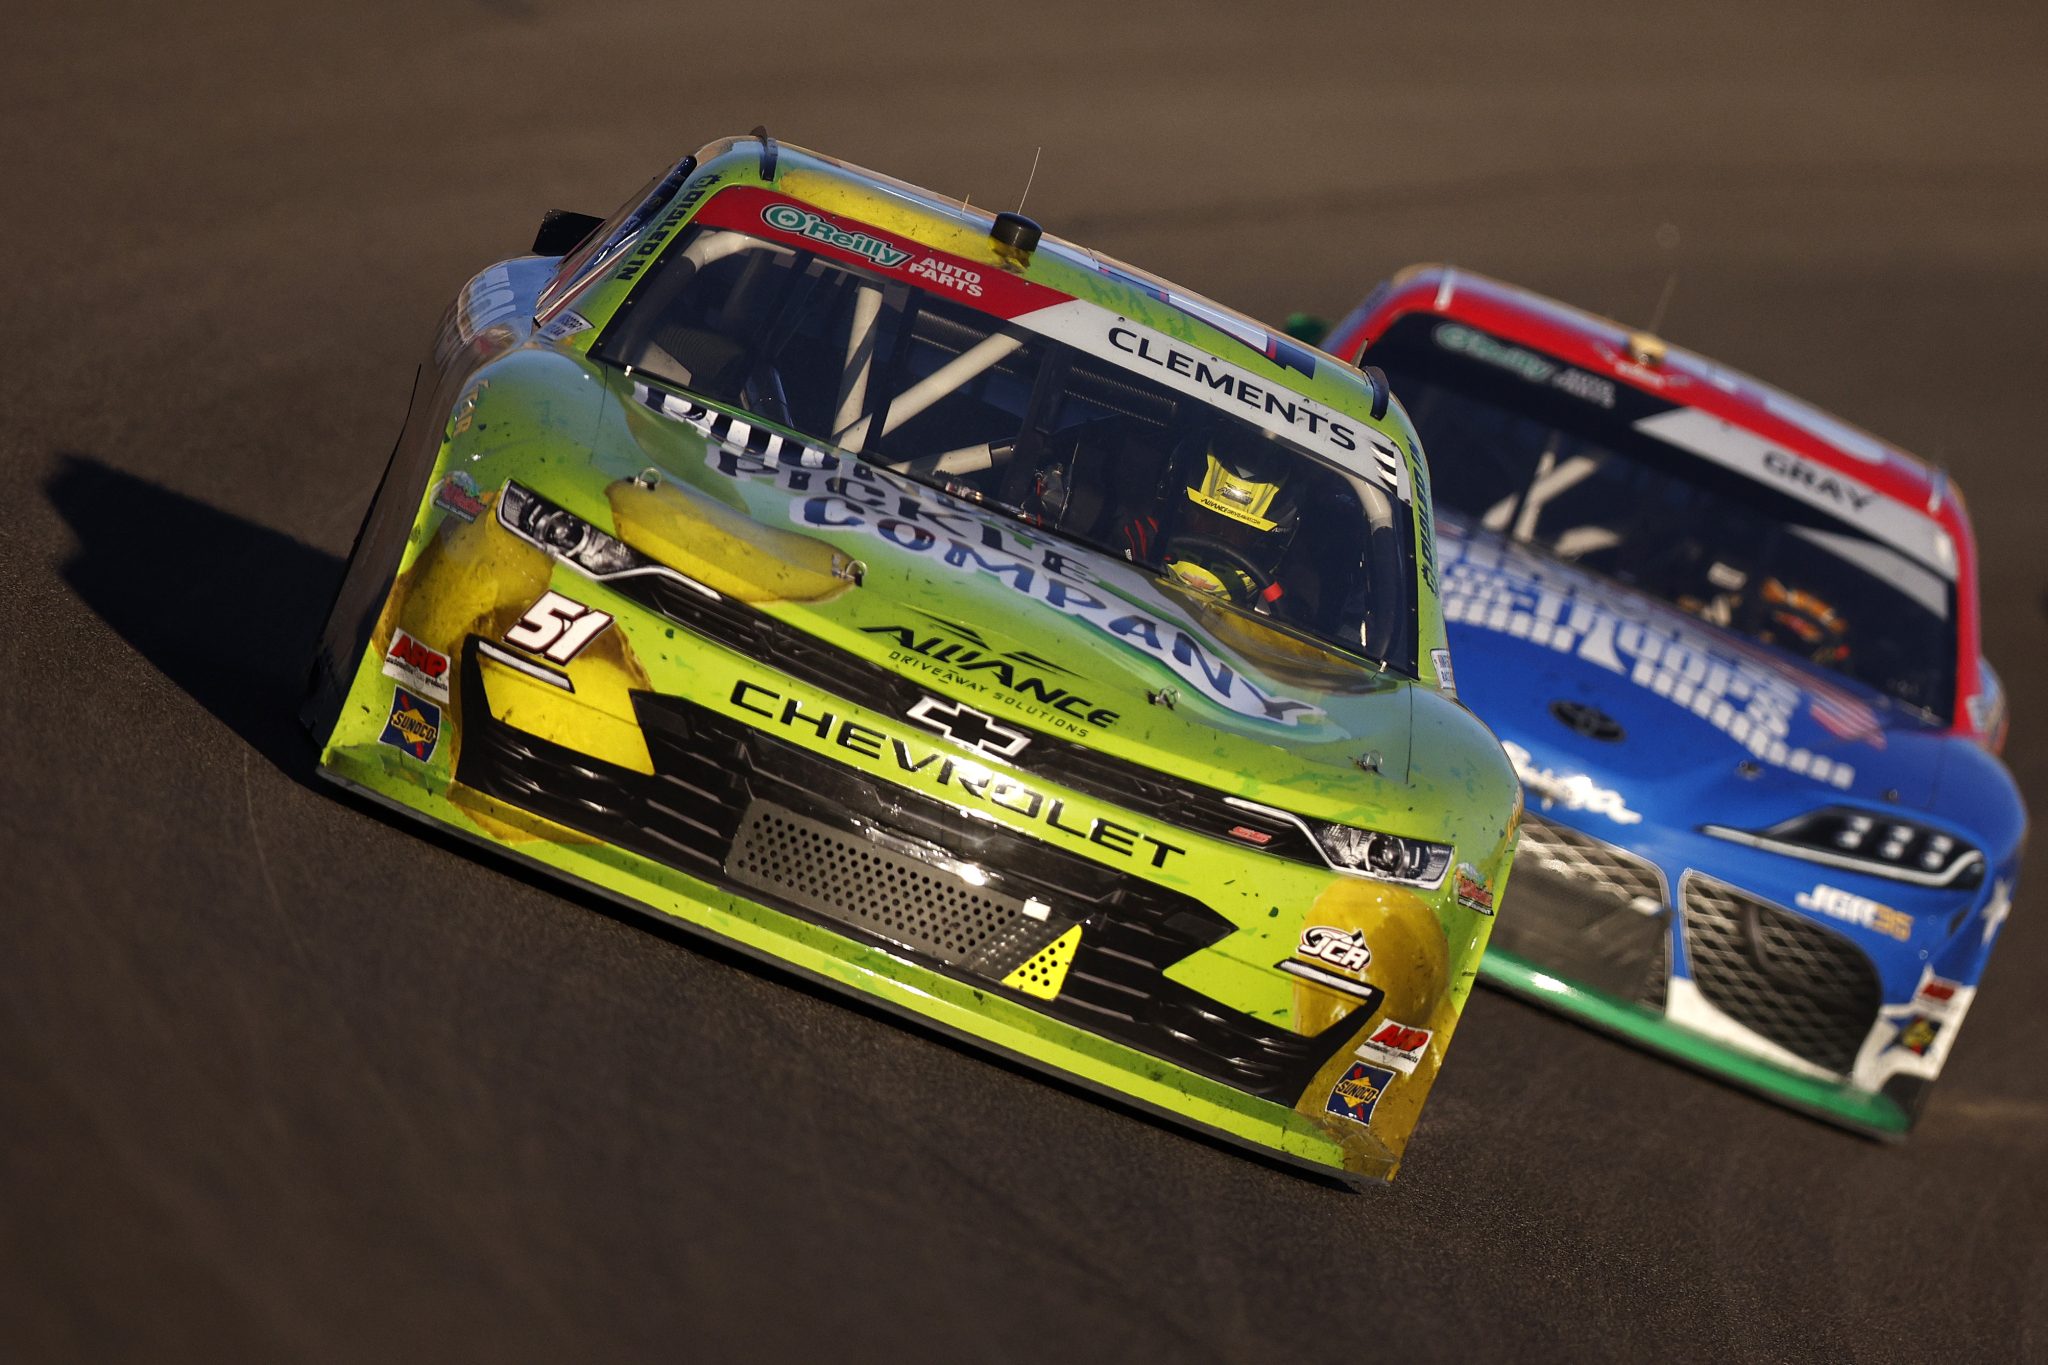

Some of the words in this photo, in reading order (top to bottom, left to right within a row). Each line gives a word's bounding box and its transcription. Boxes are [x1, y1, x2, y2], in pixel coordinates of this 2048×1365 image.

[762, 204, 911, 267] O'Reilly
[908, 262, 983, 298] PARTS
[920, 257, 982, 285] AUTO
[1107, 325, 1357, 451] CLEMENTS
[1763, 451, 1877, 512] GRAY
[716, 450, 1090, 584] PICKLE
[503, 590, 615, 667] 51
[803, 496, 1314, 721] COMPANY
[389, 633, 448, 678] ARP
[857, 626, 1121, 729] ALLIANCE
[888, 650, 989, 692] DRIVEAWAY
[993, 692, 1089, 738] SOLUTIONS
[393, 713, 435, 741] SUNOCO
[729, 678, 1186, 869] CHEVROLET
[1370, 1023, 1430, 1051] ARP
[1338, 1080, 1377, 1102] SUNOCO
